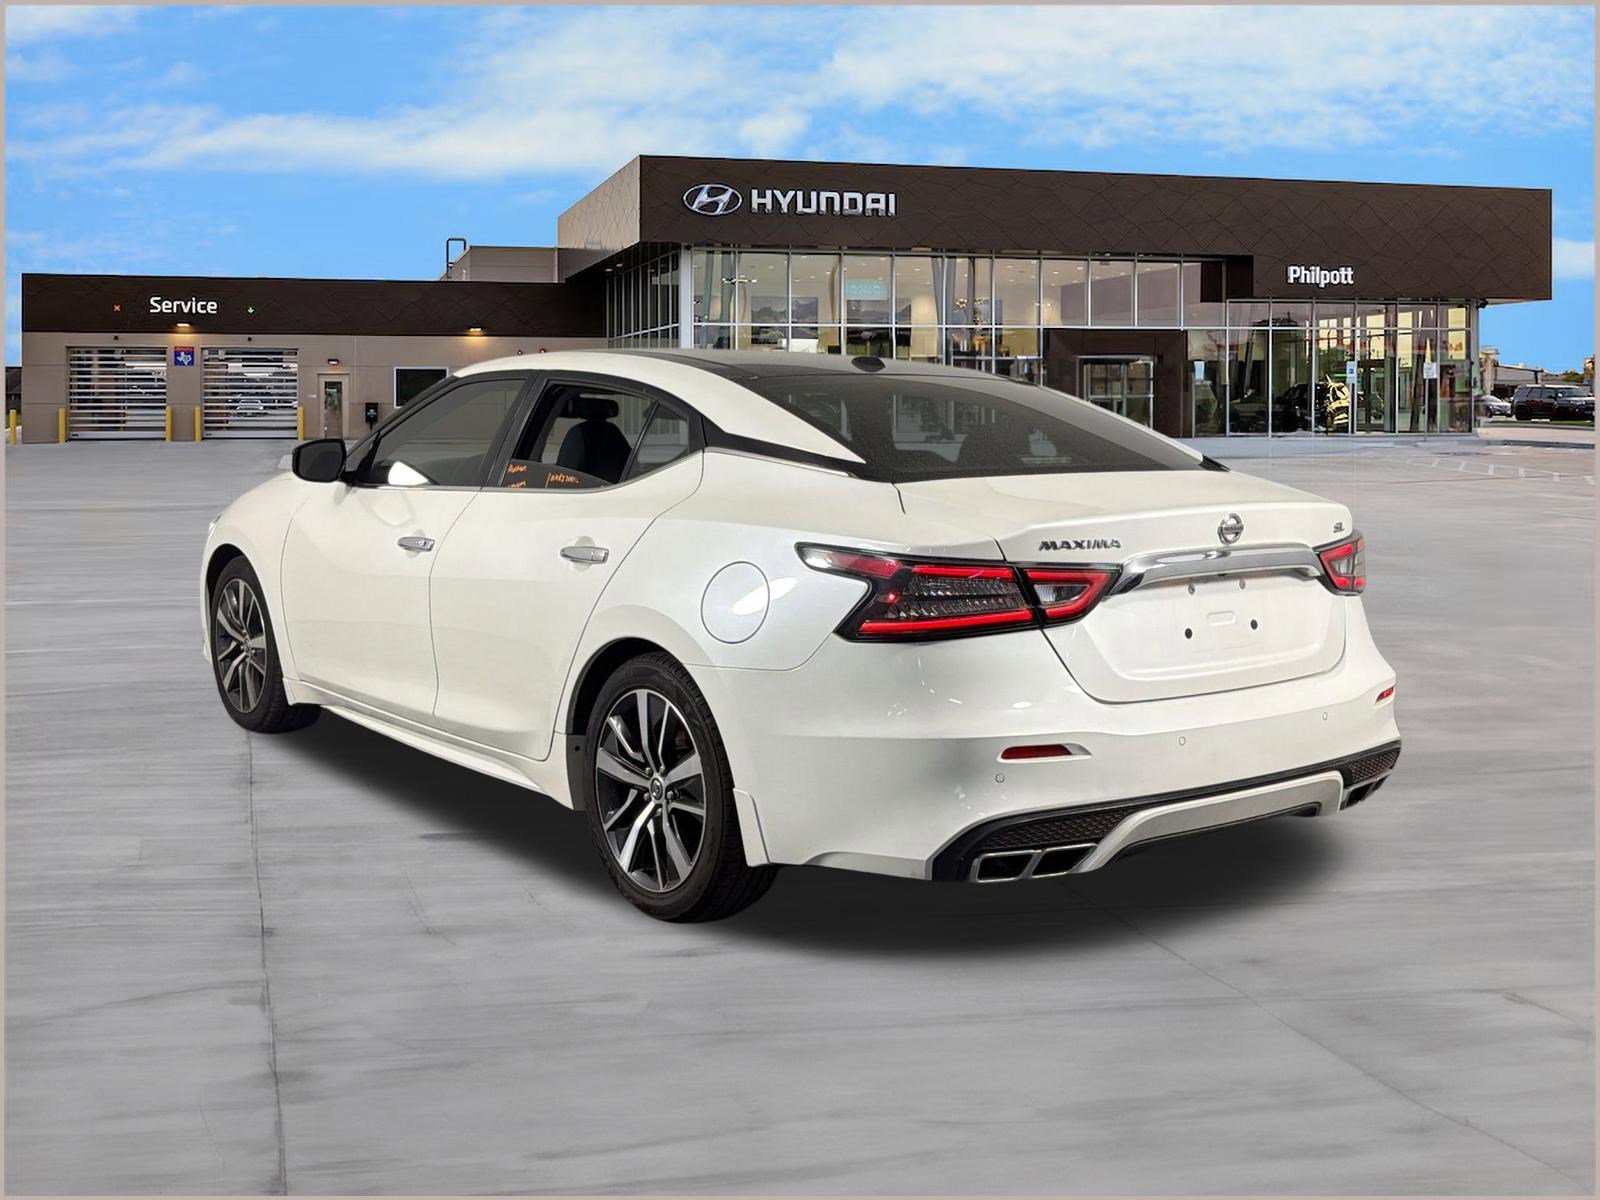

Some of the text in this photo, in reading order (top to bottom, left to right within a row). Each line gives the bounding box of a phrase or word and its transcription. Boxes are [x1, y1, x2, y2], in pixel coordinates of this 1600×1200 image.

[751, 189, 897, 217] HYUNDAI
[1287, 265, 1354, 288] Philpott
[149, 296, 218, 314] Service
[1038, 539, 1121, 551] MAXIMA
